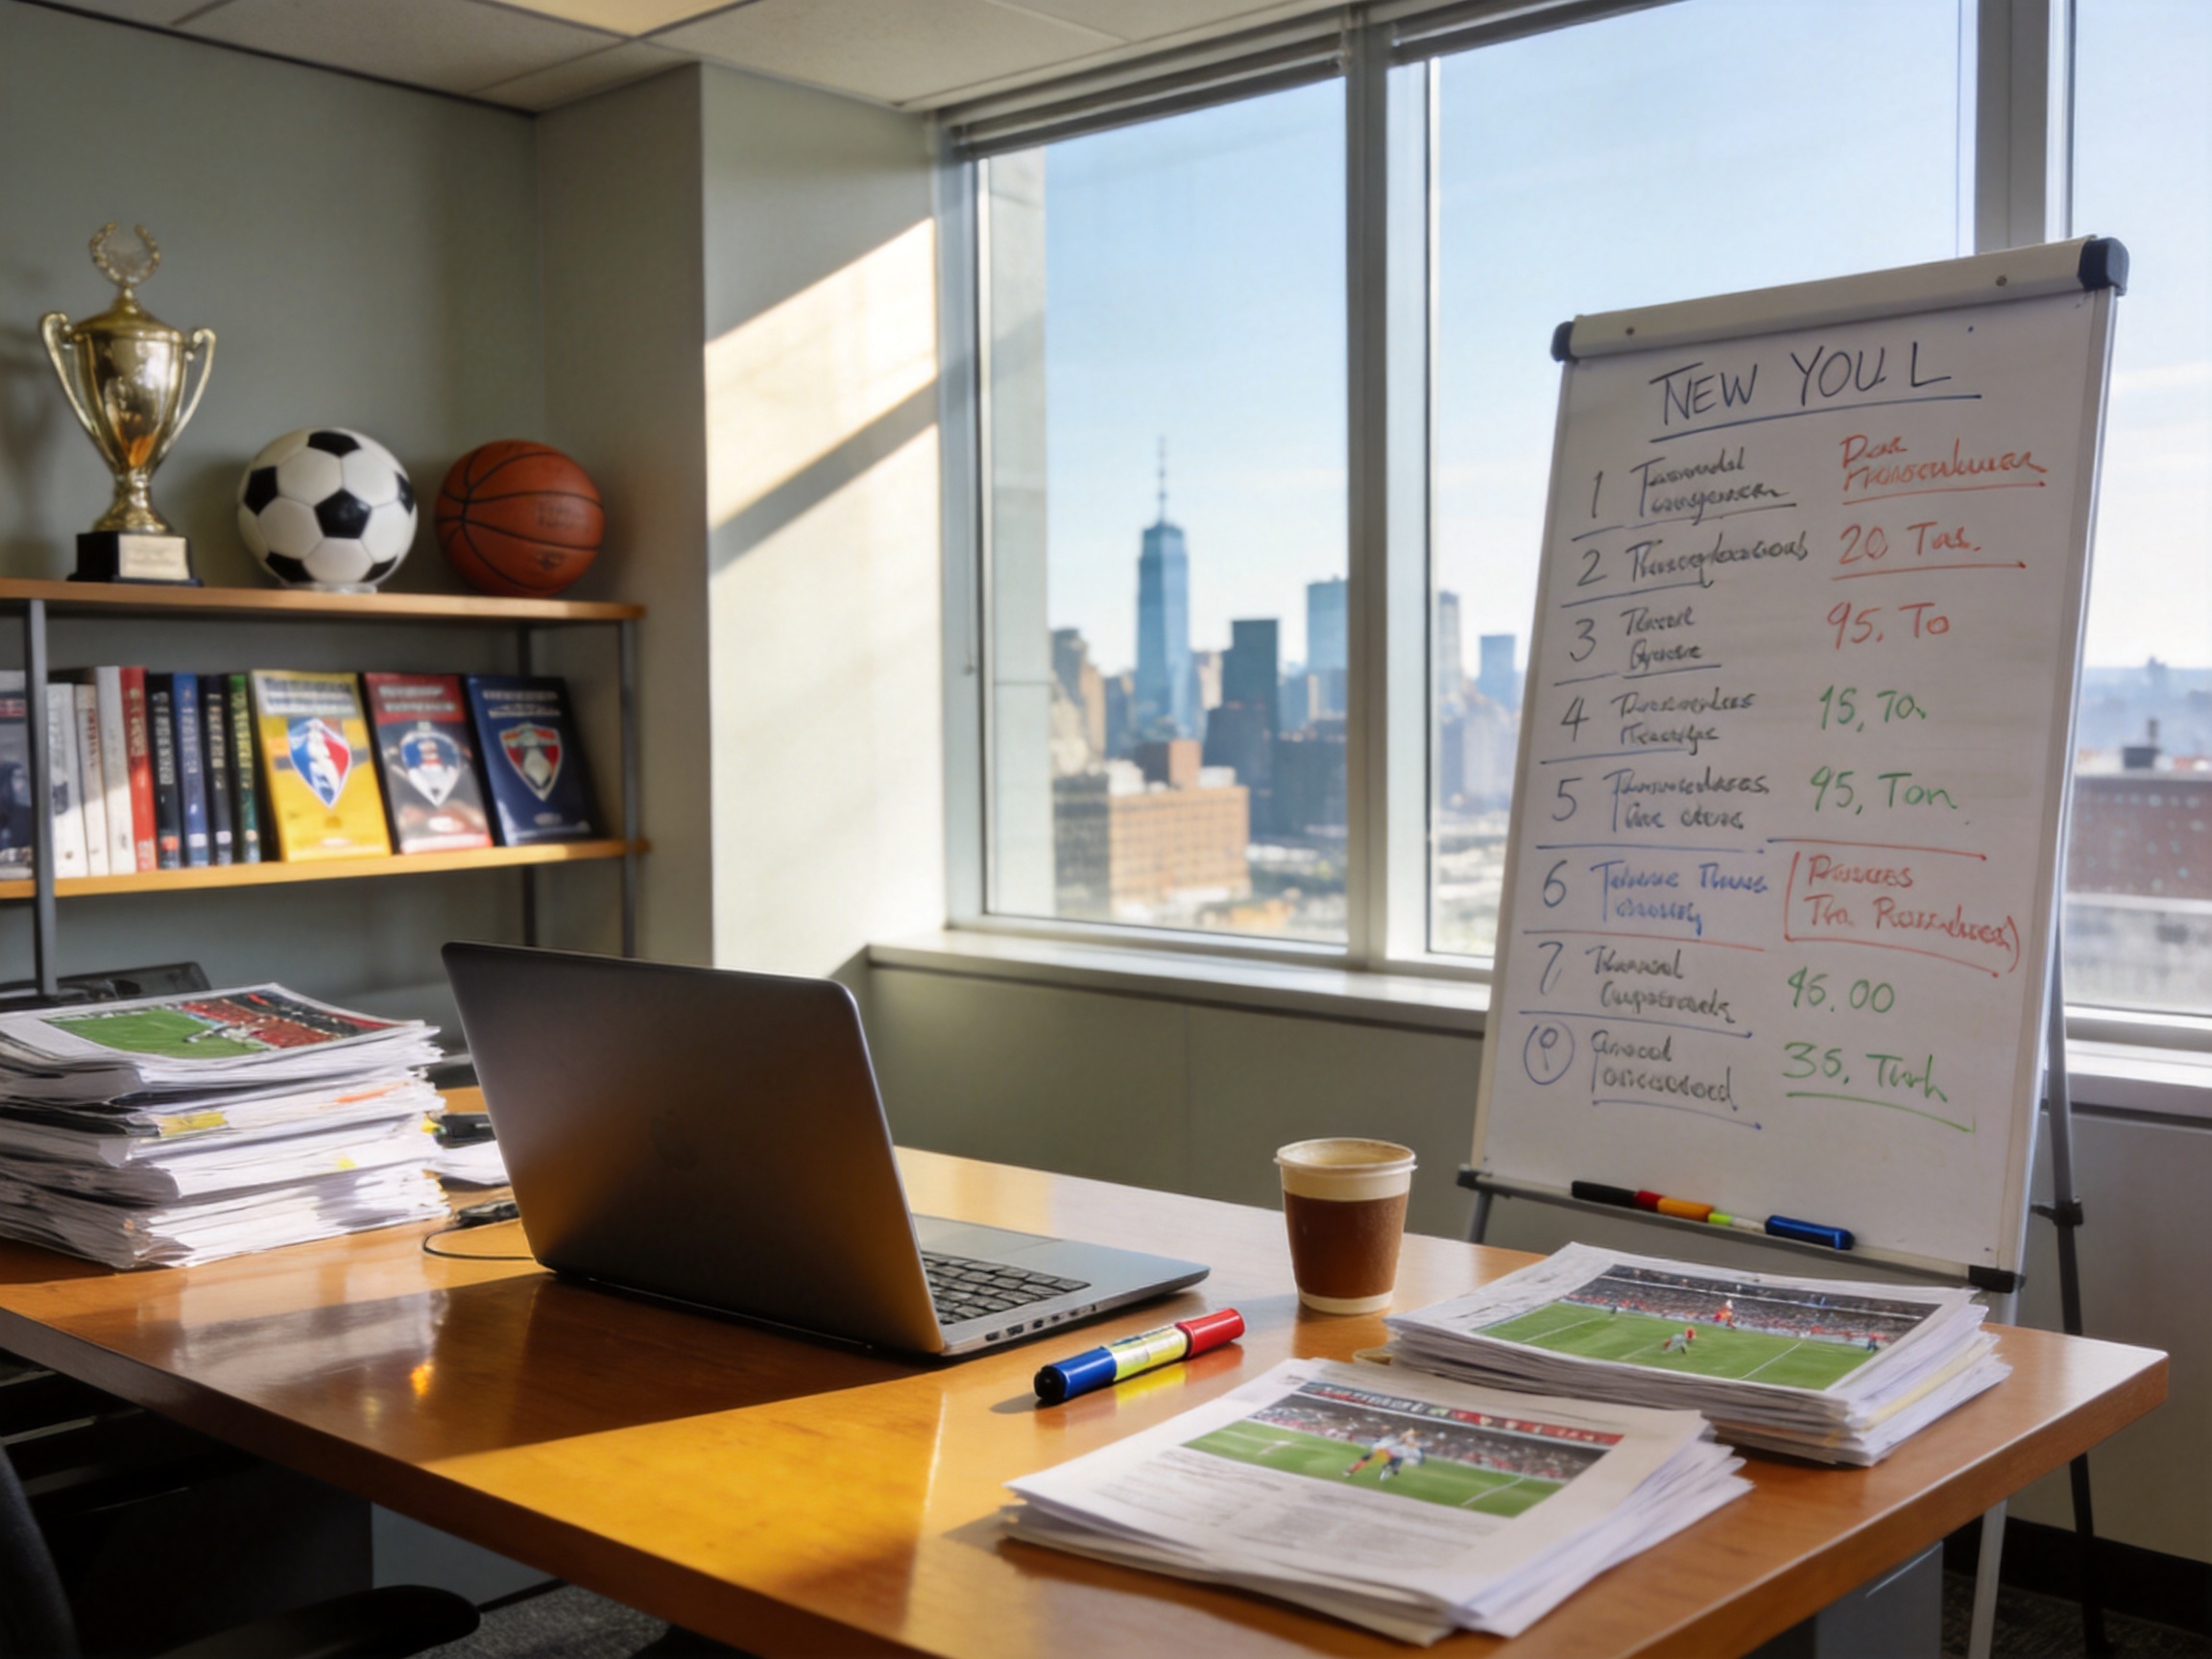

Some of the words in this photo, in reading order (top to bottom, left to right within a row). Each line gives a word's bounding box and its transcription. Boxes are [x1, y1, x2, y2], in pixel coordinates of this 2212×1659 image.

[1648, 361, 1758, 426] NEW
[1839, 523, 1889, 565] 20
[1576, 548, 1608, 588] 2
[1569, 617, 1597, 662] 3
[1560, 695, 1591, 743] 4
[1551, 777, 1583, 823] 5
[1542, 858, 1569, 908] 6
[1537, 940, 1564, 997] 7
